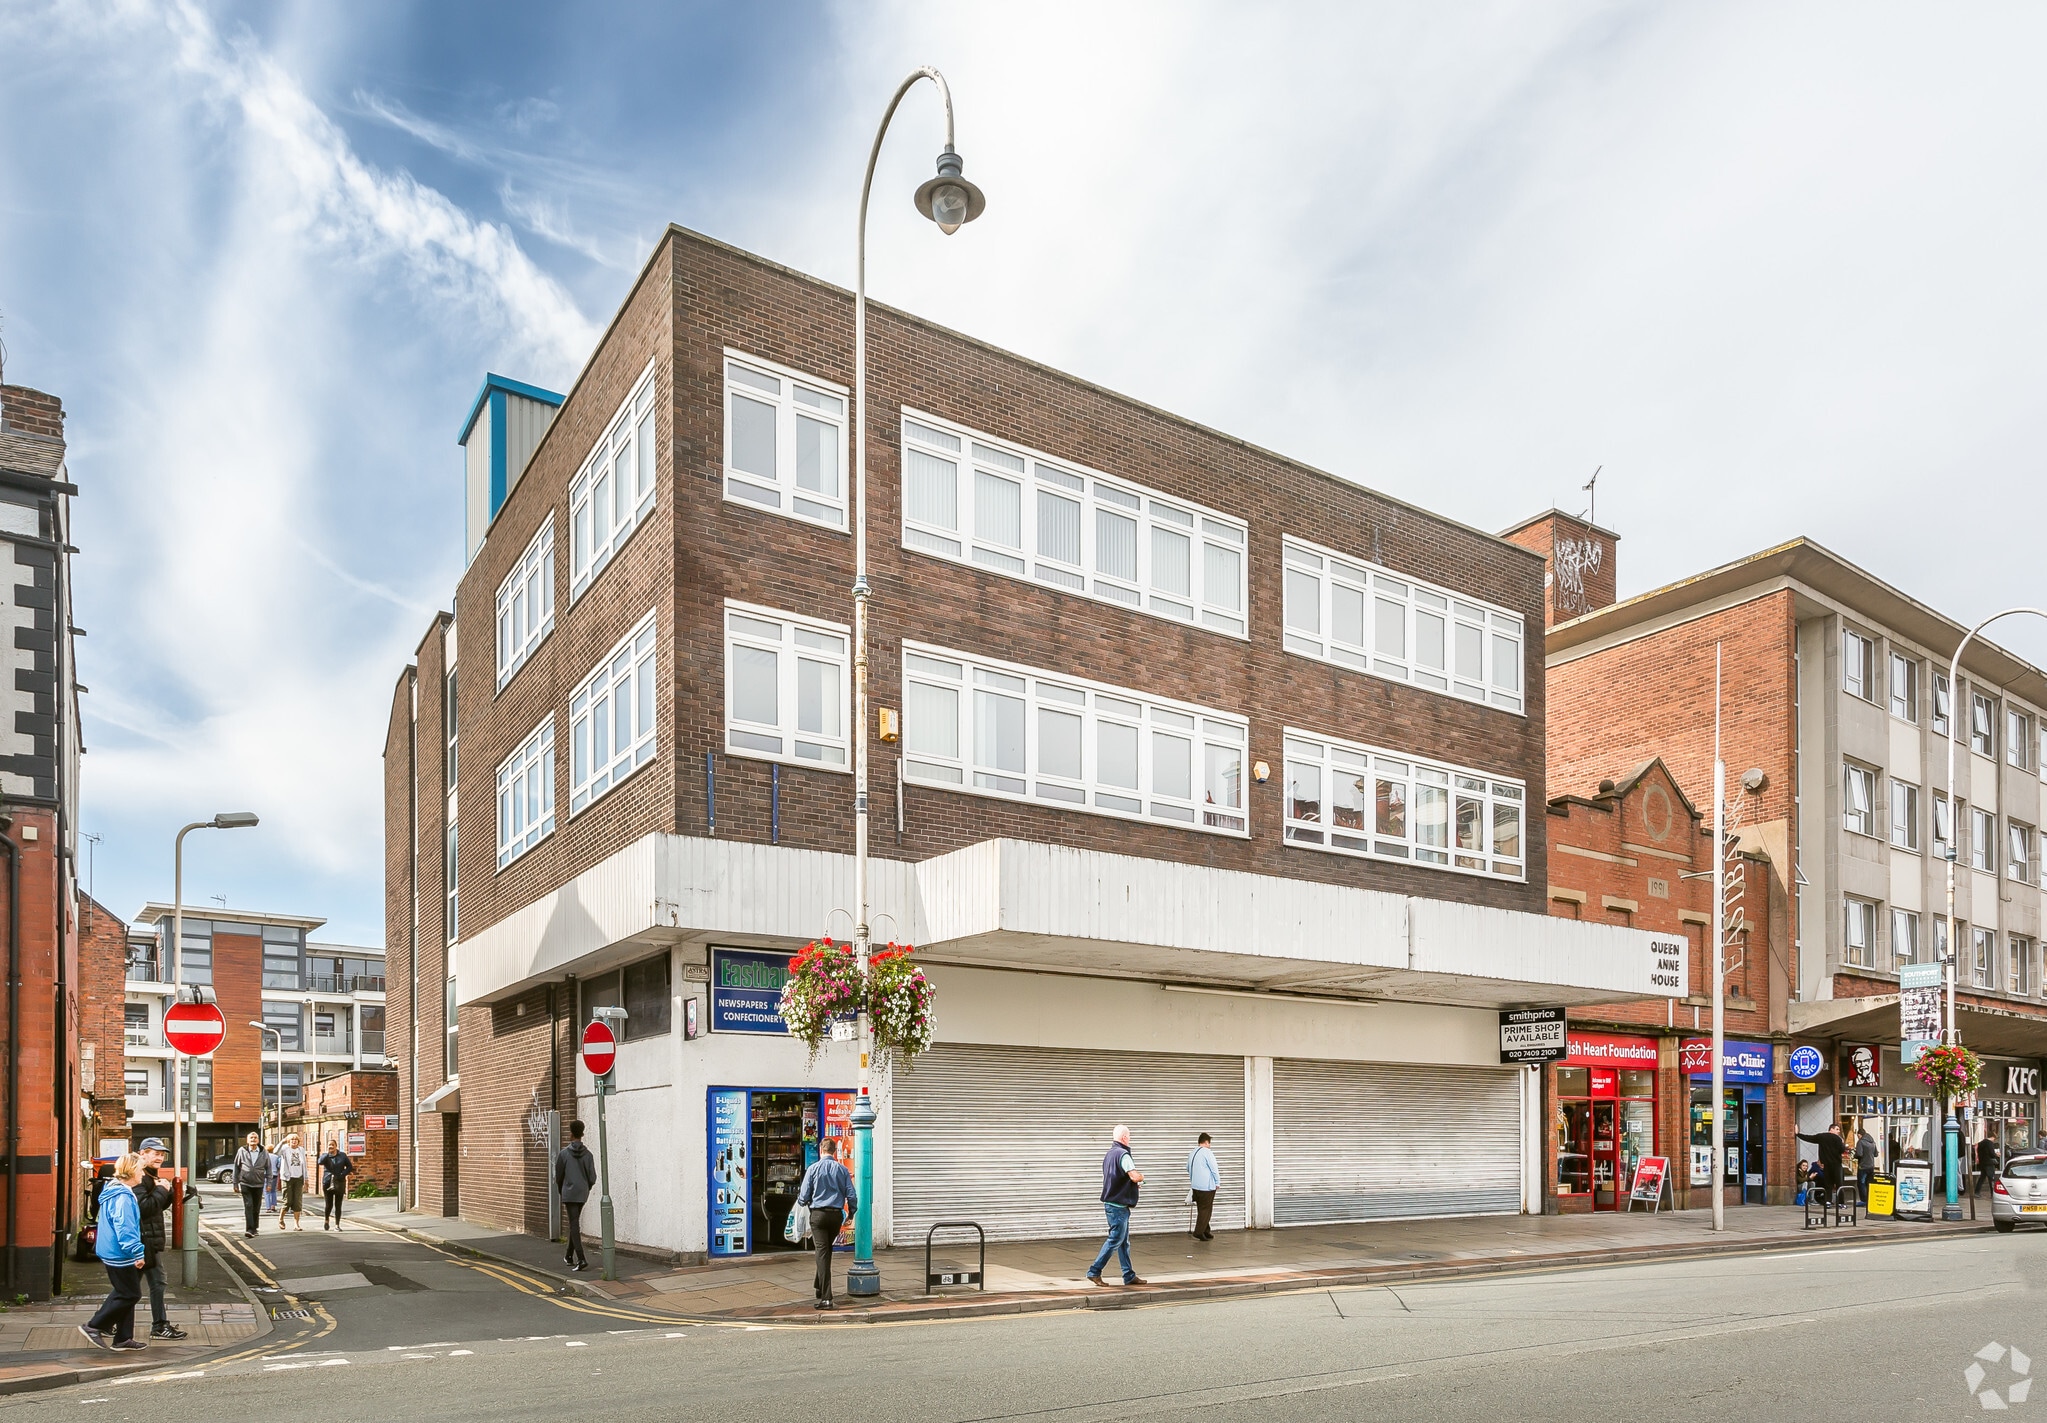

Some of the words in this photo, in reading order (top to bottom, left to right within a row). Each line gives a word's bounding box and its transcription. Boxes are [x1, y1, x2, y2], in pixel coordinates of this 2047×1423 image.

[1651, 941, 1680, 955] QUEEN
[1657, 959, 1680, 972] ANNE
[1651, 974, 1680, 987] HOUSE
[718, 998, 768, 1010] NEWSPAPERS
[723, 1012, 783, 1024] CONFECTIONERY
[1508, 1010, 1555, 1022] smithprice
[1504, 1025, 1532, 1035] PRIME
[1534, 1023, 1561, 1033] SHOP
[1506, 1032, 1560, 1043] AVAILABLE
[1583, 1042, 1608, 1057] Heart
[1608, 1043, 1657, 1060] Foundation
[1793, 1049, 1818, 1061] PHONE
[1738, 1052, 1766, 1069] Clinic
[1793, 1063, 1817, 1076] CLINIC
[2006, 1066, 2037, 1096] KFC
[716, 1096, 741, 1104] E-Liquids
[716, 1106, 734, 1115] E-Cigs
